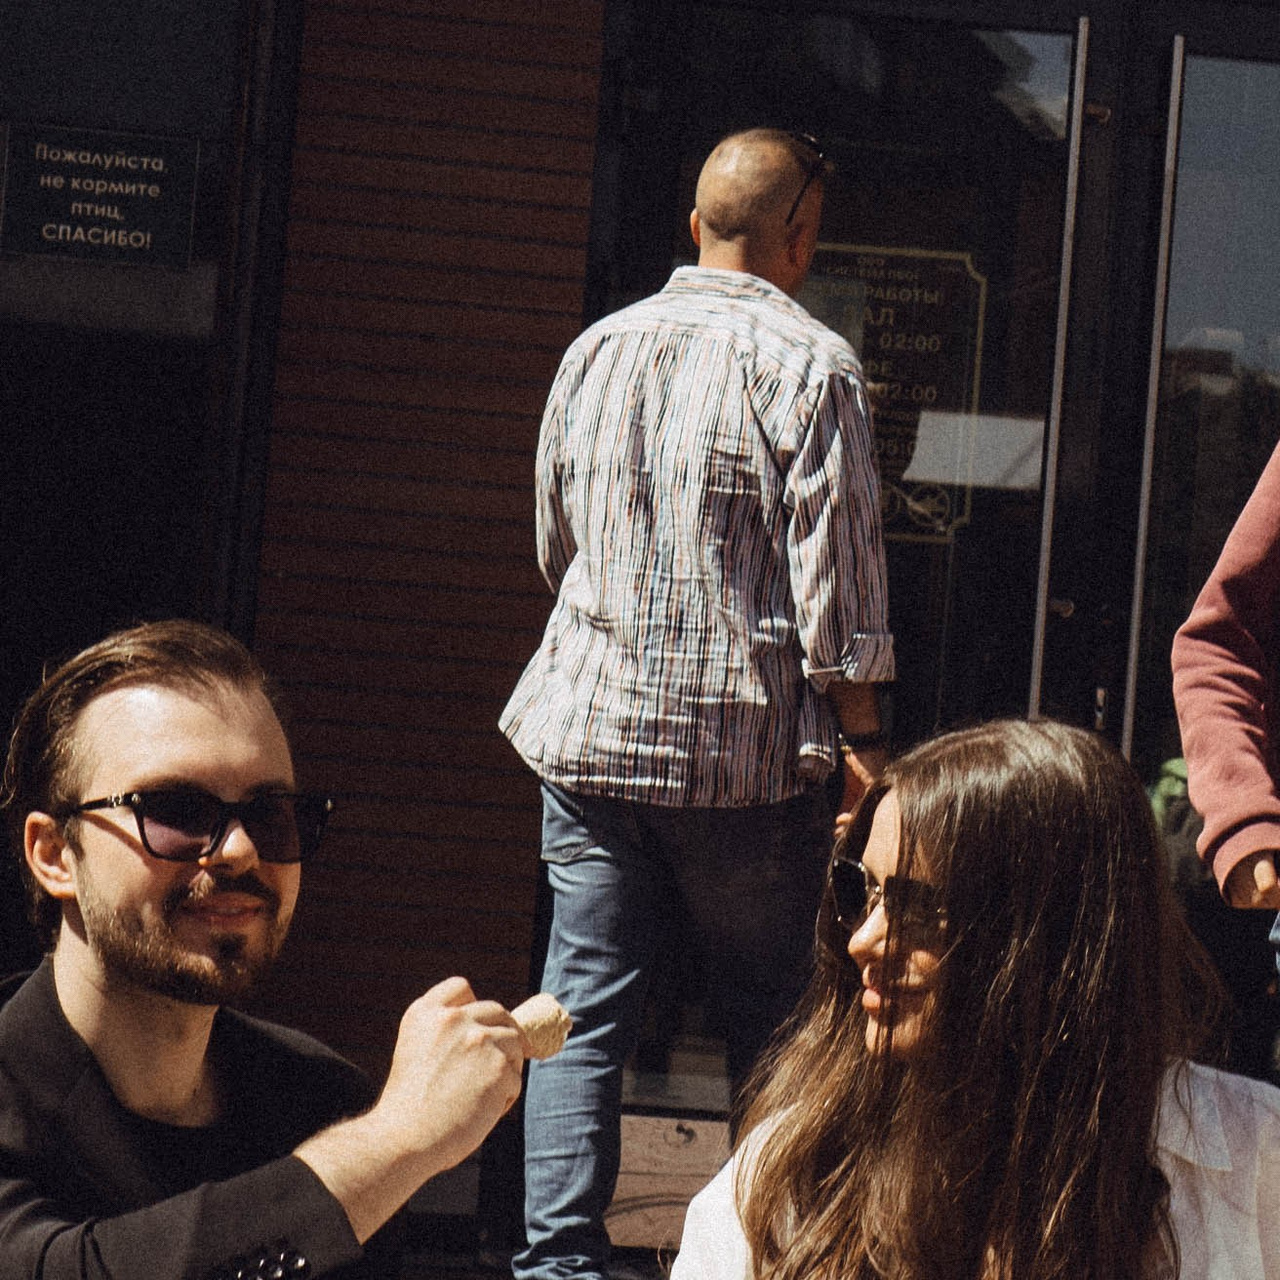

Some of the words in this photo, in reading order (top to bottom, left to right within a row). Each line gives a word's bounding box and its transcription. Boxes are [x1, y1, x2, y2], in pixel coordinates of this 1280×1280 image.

[40, 175, 65, 189] не
[71, 177, 161, 198] кормите
[42, 223, 152, 250] СПАСИБО!
[864, 284, 940, 305] РАБОТЫ
[879, 331, 941, 353] 02:00
